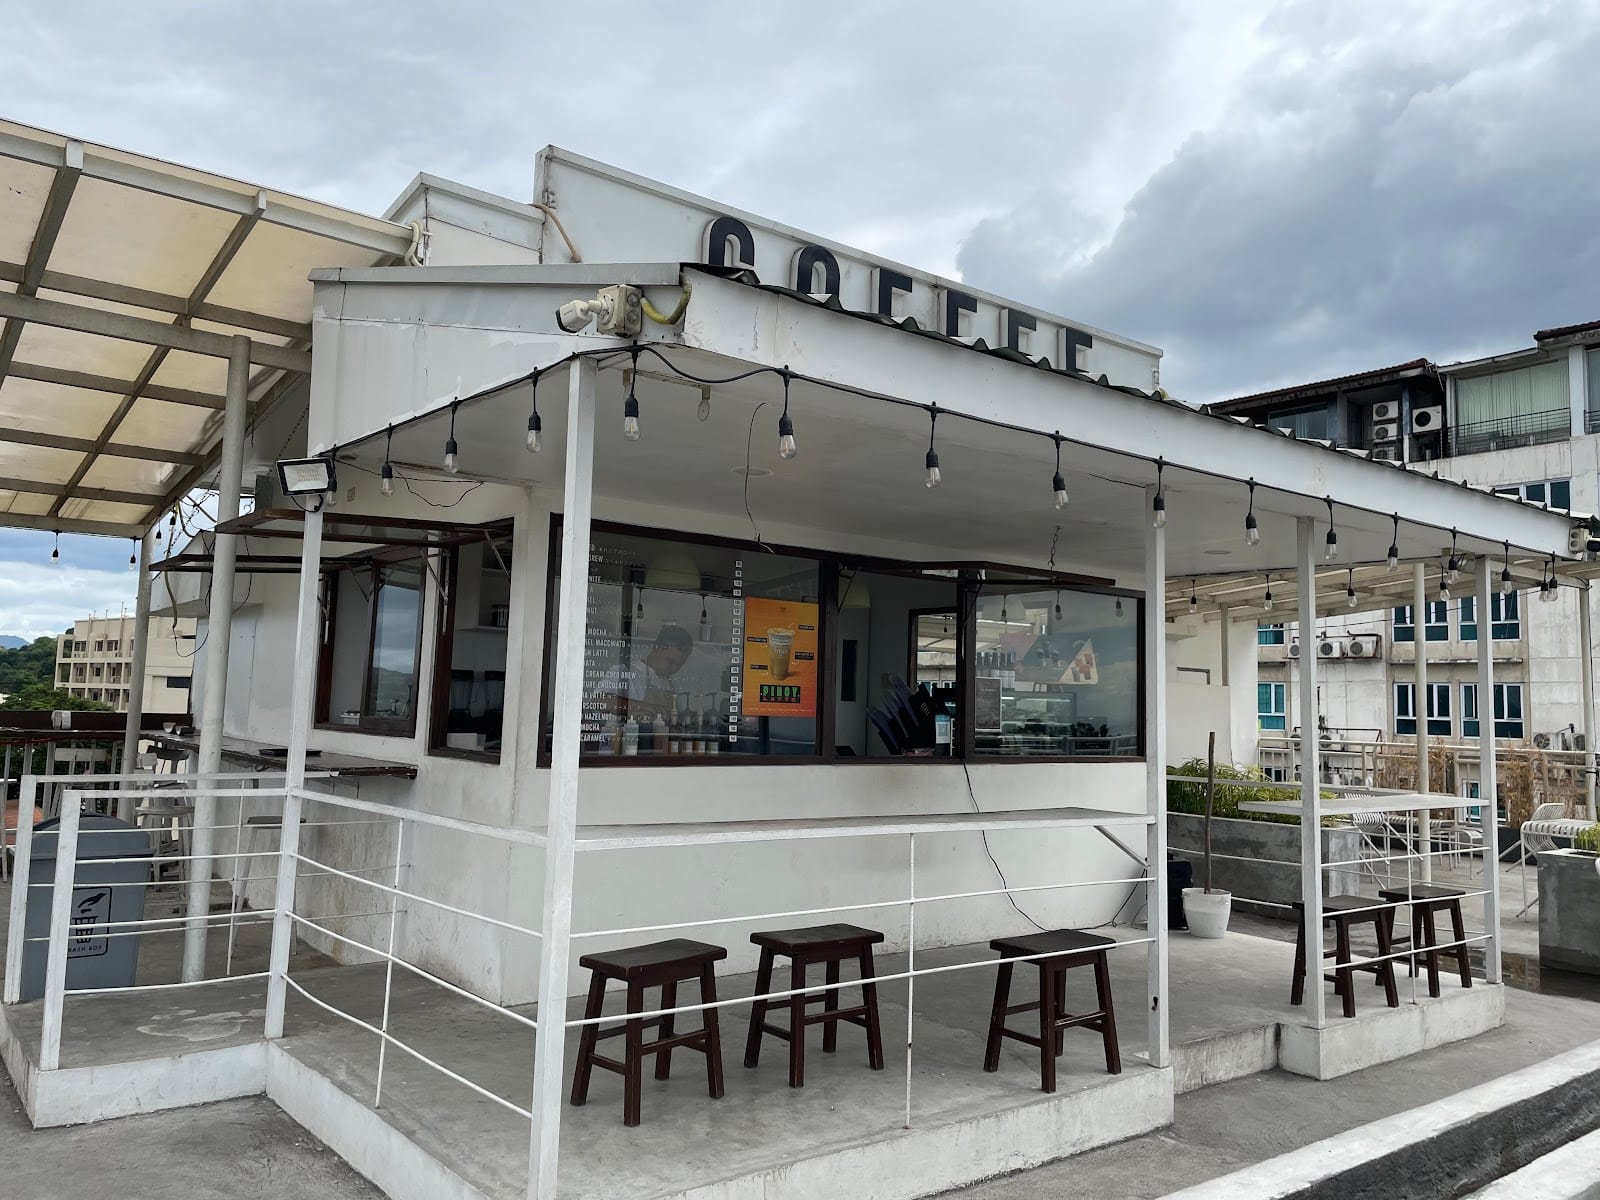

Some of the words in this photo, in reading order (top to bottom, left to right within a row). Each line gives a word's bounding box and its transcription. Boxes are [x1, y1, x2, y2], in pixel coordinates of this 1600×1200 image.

[595, 639, 626, 648] MACCHIATO
[592, 649, 609, 658] LATTE
[585, 670, 605, 679] CREAM
[620, 671, 637, 680] BREW
[597, 681, 628, 690] CHOCOLATE
[590, 691, 607, 700] LATTE
[762, 685, 798, 698] PINOY
[582, 701, 608, 711] RSCOTCH
[584, 712, 612, 722] HAZELNUT
[580, 734, 606, 743] CARAMEL
